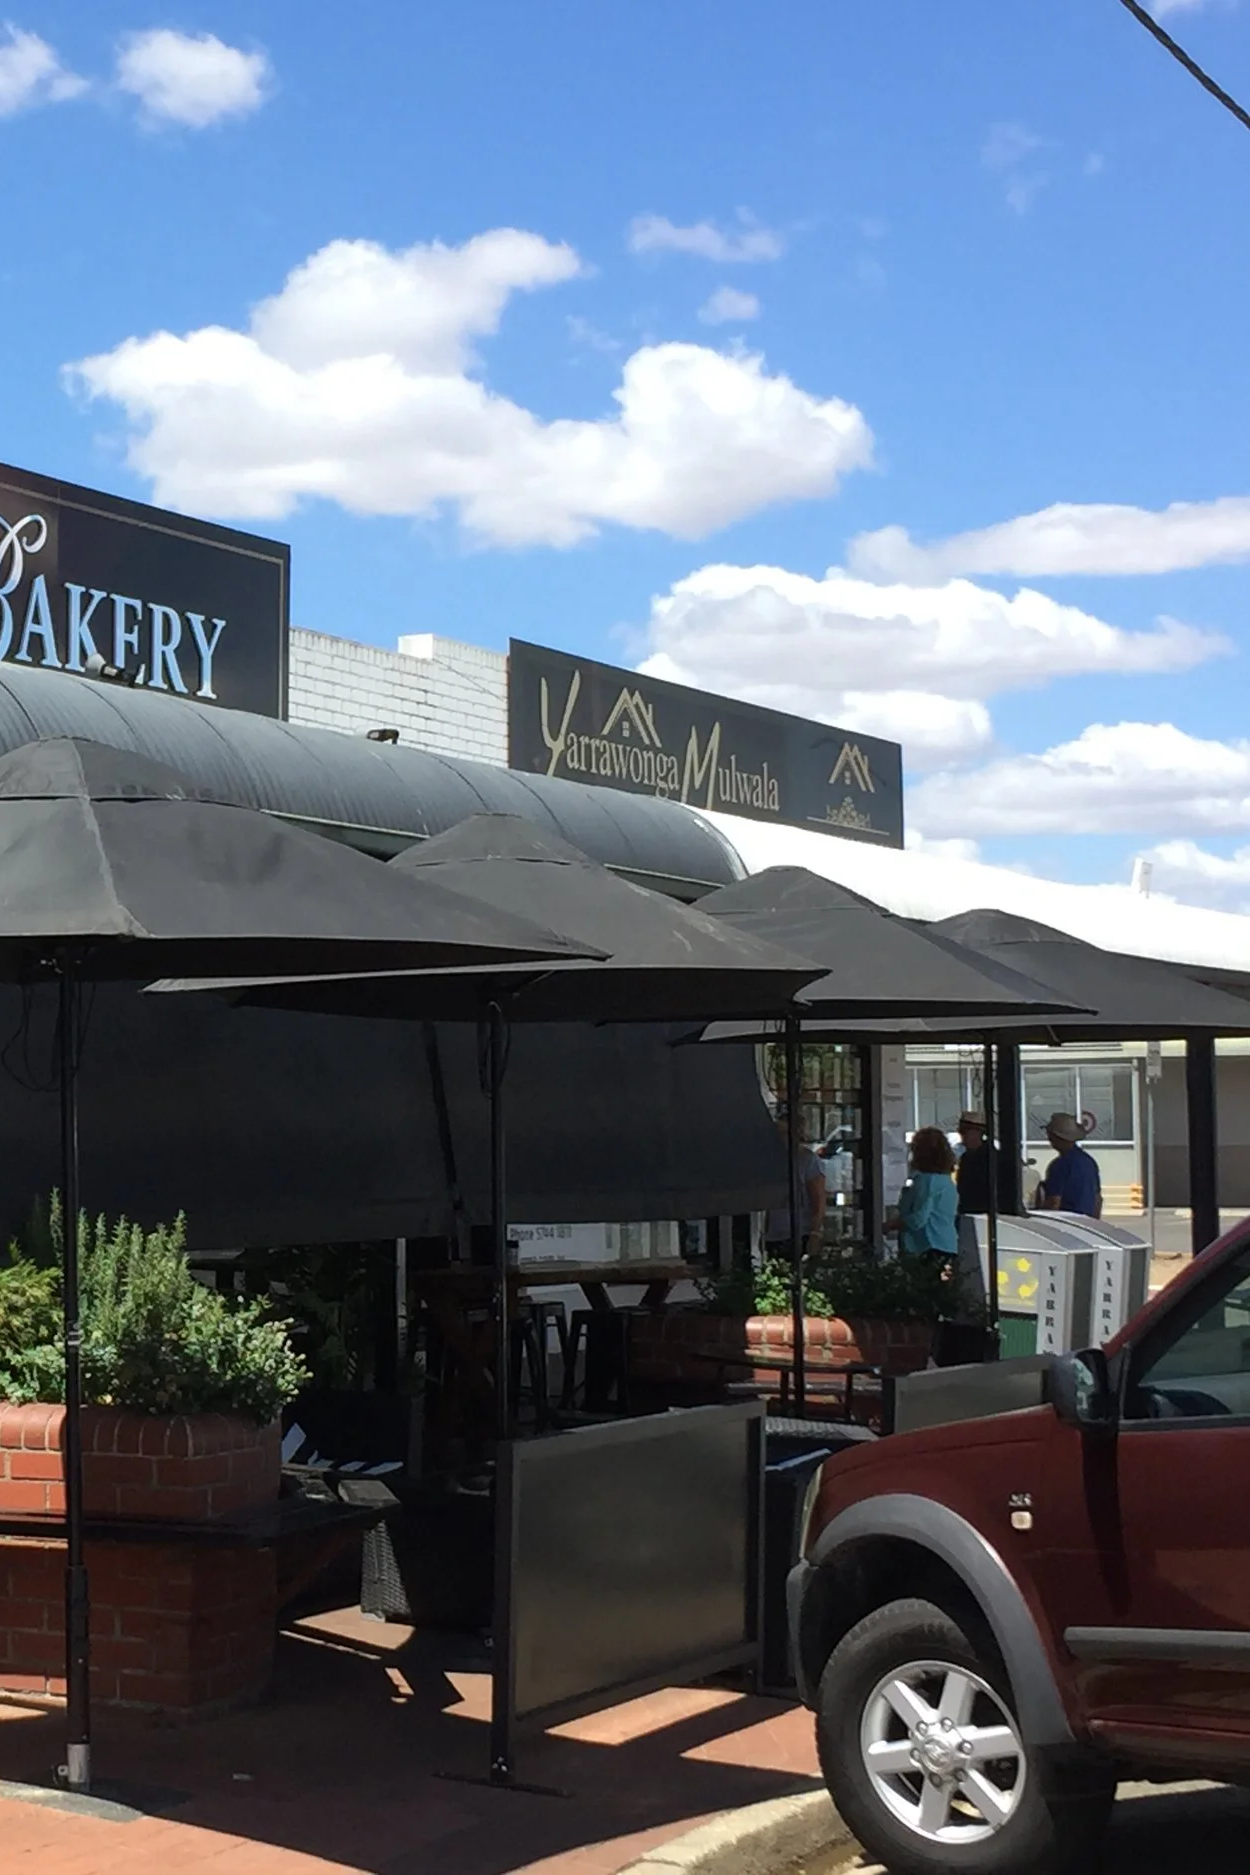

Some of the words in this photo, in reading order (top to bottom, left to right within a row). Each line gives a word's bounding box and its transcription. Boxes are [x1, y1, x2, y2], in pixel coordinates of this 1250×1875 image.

[540, 669, 680, 799] Yarrawonga
[680, 721, 781, 812] Mulwala
[509, 1226, 534, 1241] Phone
[1100, 1259, 1114, 1345] YARRA
